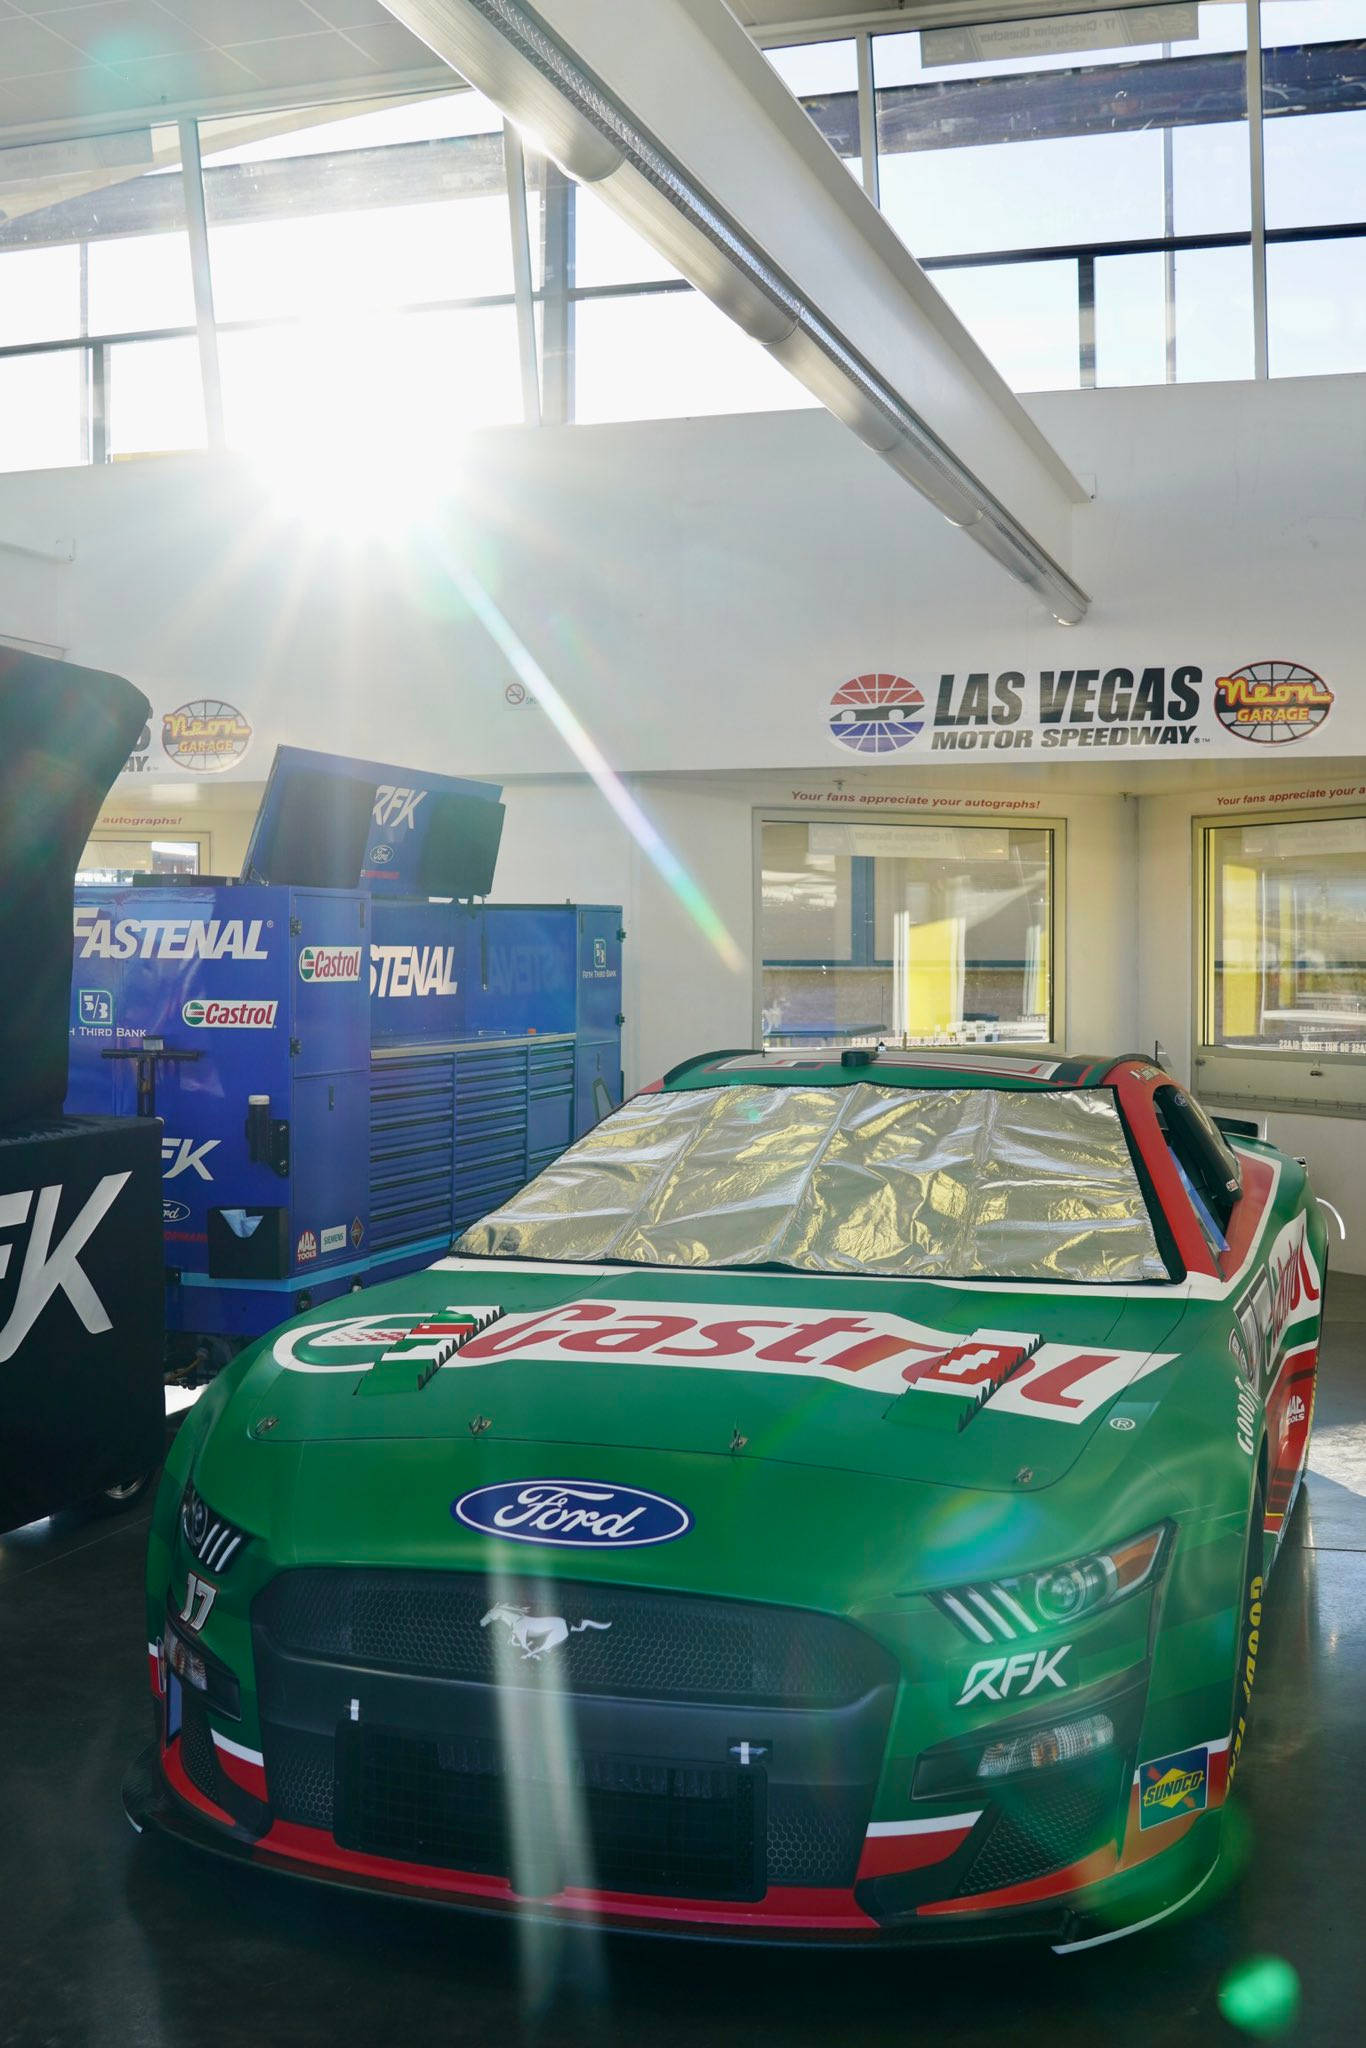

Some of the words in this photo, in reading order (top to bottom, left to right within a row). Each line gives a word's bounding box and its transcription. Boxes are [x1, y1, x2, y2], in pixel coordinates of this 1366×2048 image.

[932, 670, 1025, 726] LAS
[1039, 665, 1203, 724] VEGAS
[1214, 676, 1334, 707] Neon
[163, 713, 253, 740] Neon
[1236, 706, 1309, 723] GARAGE
[177, 740, 234, 753] GARAGE
[930, 729, 1033, 750] MOTOR
[1040, 725, 1199, 748] SPEEDWAY
[791, 790, 822, 801] Your
[826, 791, 856, 802] fans
[859, 793, 929, 805] appreciate
[931, 797, 962, 807] your
[964, 798, 1041, 810] autographs!
[1216, 797, 1240, 806] Your
[1243, 795, 1266, 803] fans
[1268, 789, 1326, 803] appreciate
[1325, 786, 1356, 799] your
[102, 817, 182, 827] autographs!
[73, 907, 269, 960] FASTENAL
[314, 950, 360, 983] Castrol
[205, 1003, 274, 1026] Castrol
[79, 1026, 113, 1036] THIRD
[116, 1027, 147, 1038] BANK
[323, 1232, 345, 1246] SIEMENS
[456, 1303, 1118, 1408] Castrol
[494, 1484, 645, 1540] Ford
[179, 1571, 218, 1632] 17
[955, 1645, 1073, 1706] RFK
[1144, 1771, 1203, 1805] SUNOCO
